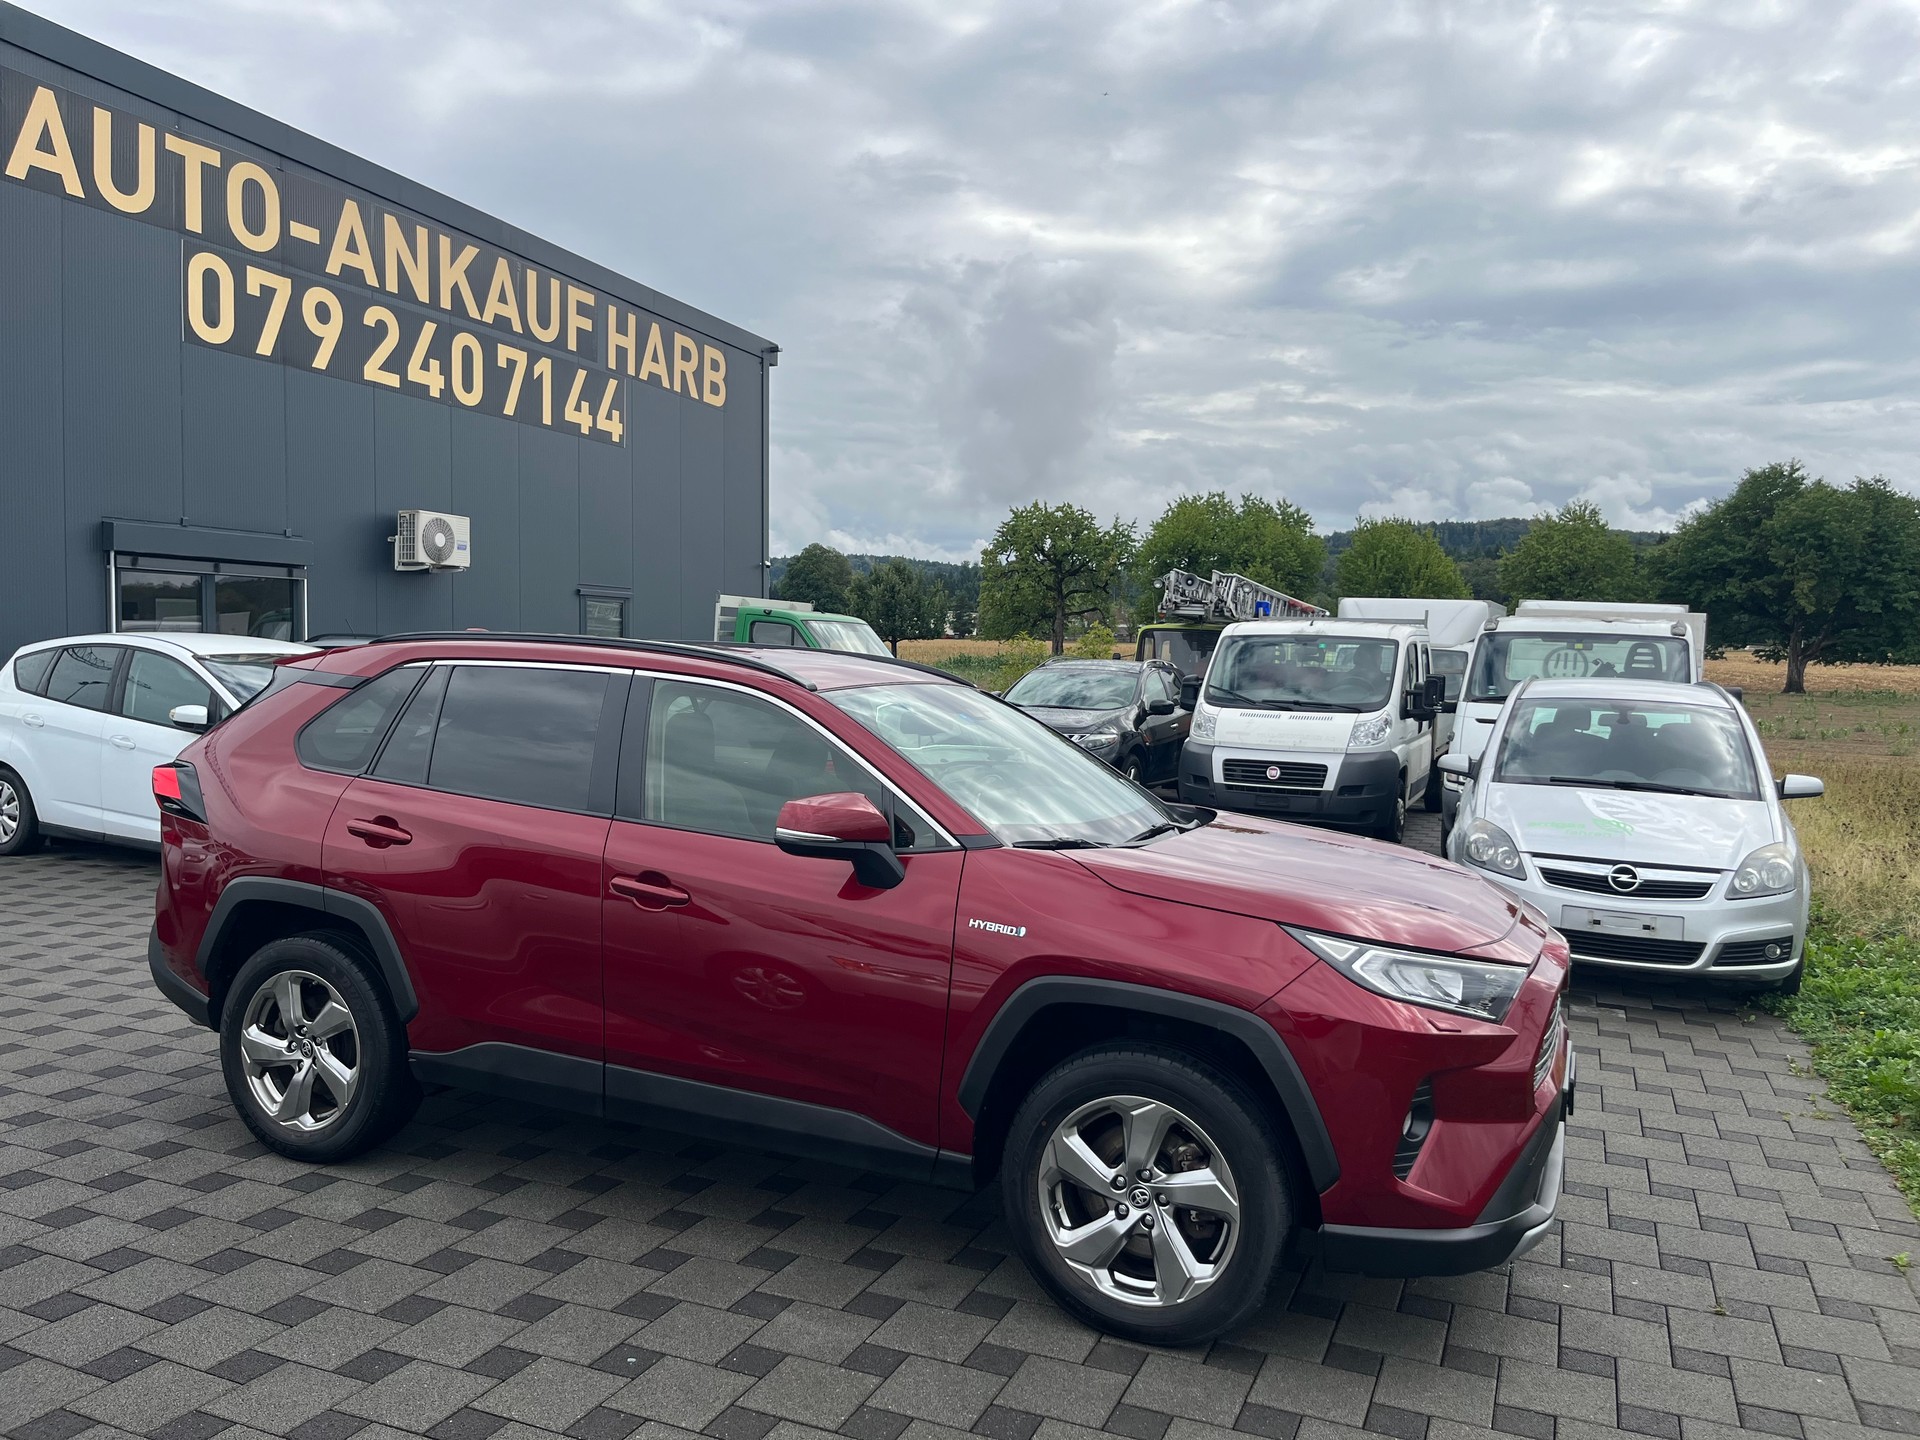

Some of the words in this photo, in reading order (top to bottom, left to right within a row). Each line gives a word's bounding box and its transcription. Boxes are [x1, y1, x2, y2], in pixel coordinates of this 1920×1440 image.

[5, 86, 596, 353] AUTO-ANKAUF
[607, 304, 727, 407] HARB
[188, 252, 343, 370] 079
[363, 305, 484, 407] 240
[968, 918, 1018, 936] HYBRID
